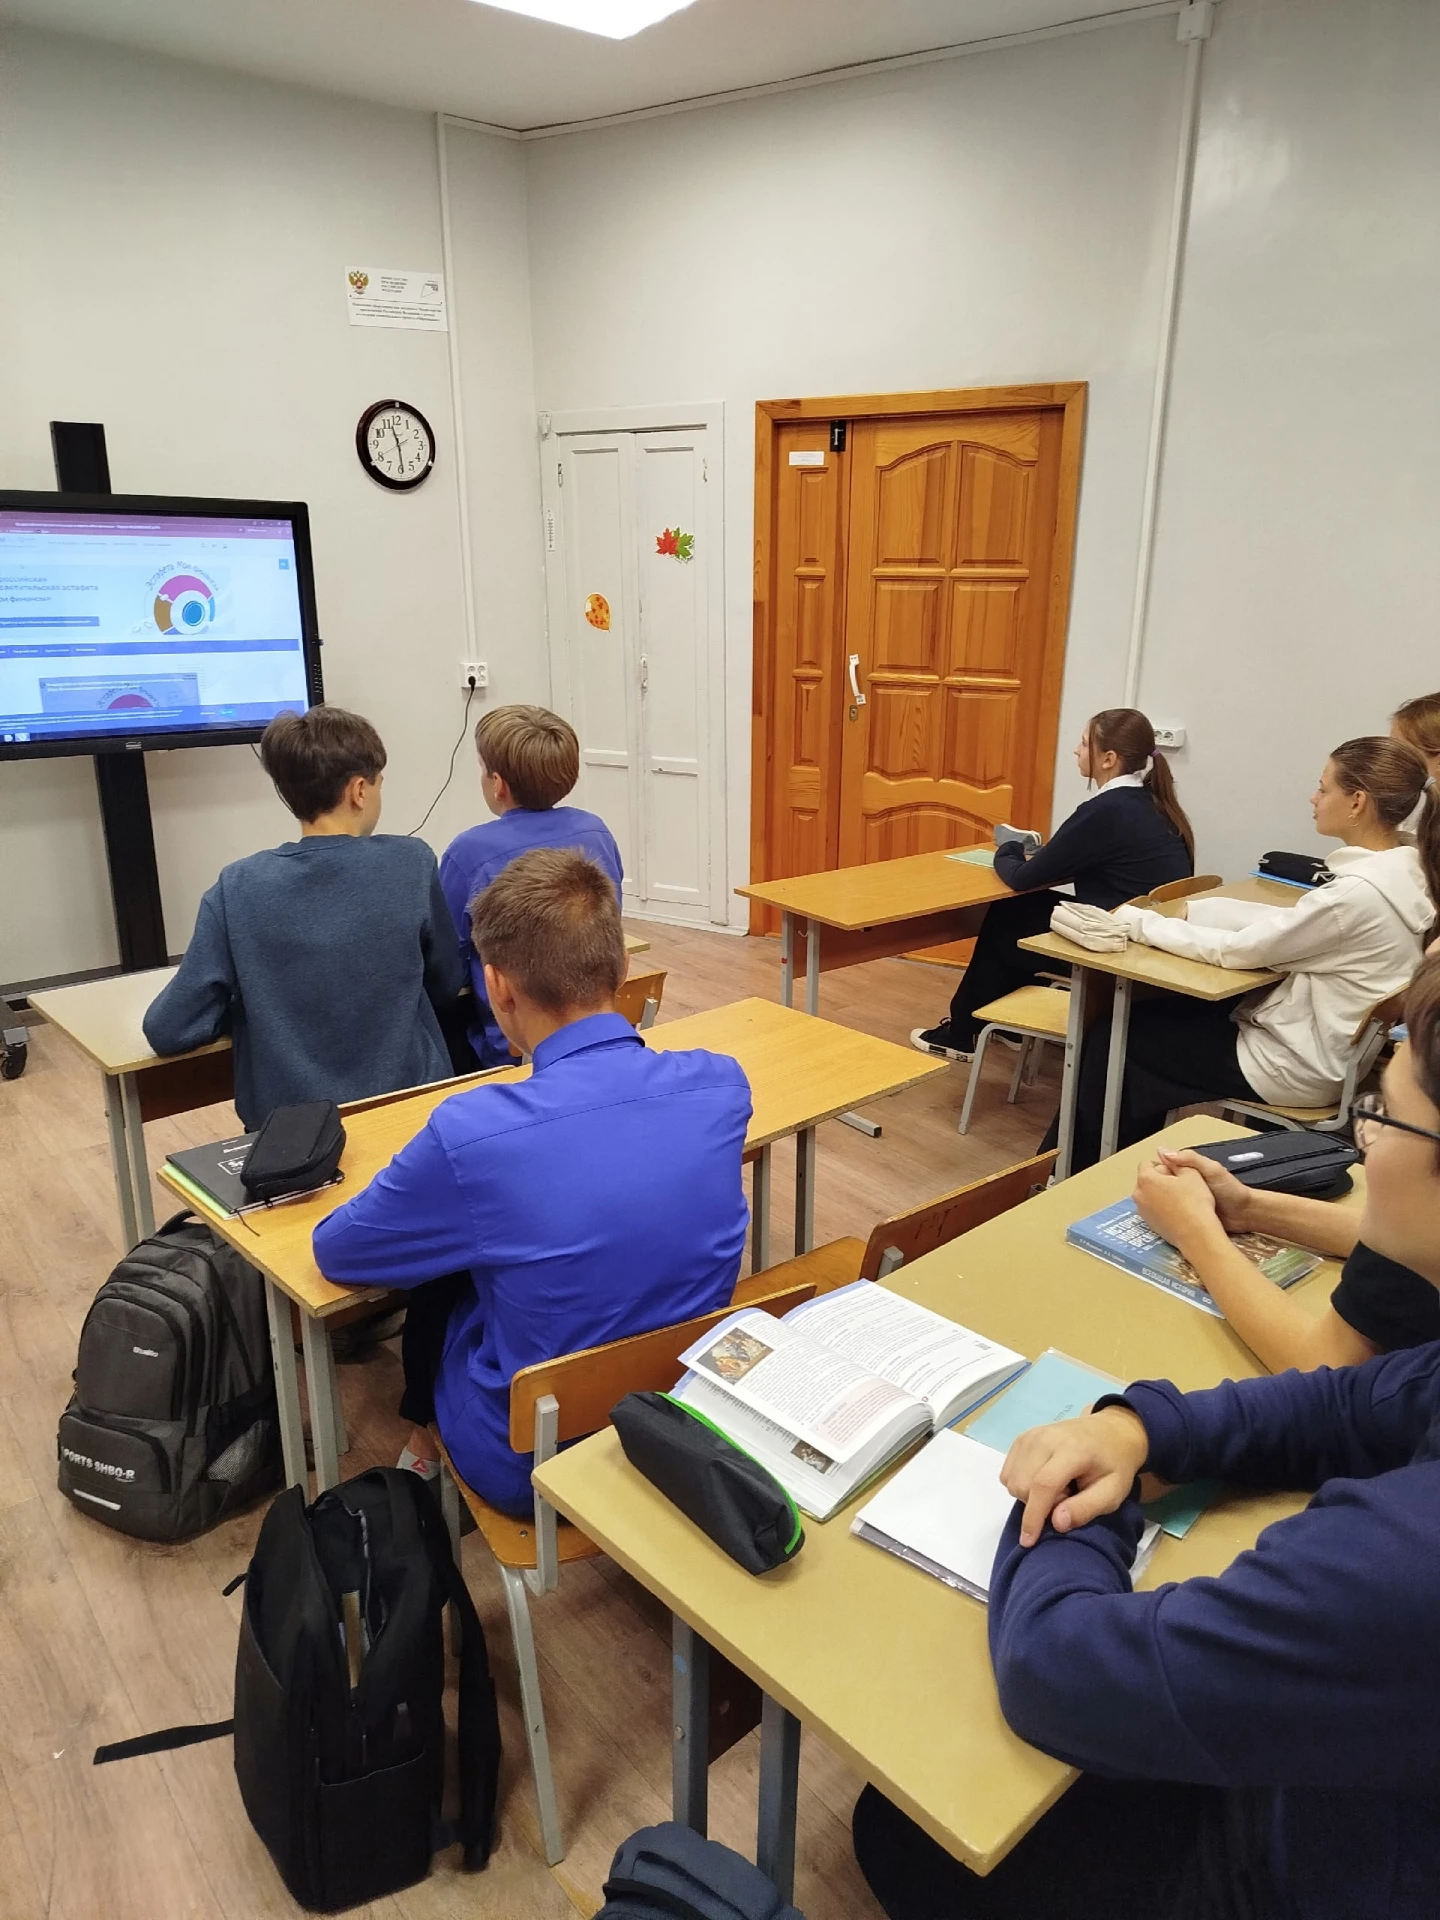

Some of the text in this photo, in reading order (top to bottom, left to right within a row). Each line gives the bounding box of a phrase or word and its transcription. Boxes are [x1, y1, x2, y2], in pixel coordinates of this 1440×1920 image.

[382, 419, 392, 429] 11
[392, 415, 402, 425] 12
[405, 419, 410, 430] 1
[375, 428, 385, 438] 10
[413, 429, 420, 439] 2
[373, 439, 379, 449] 9
[418, 440, 424, 450] 3
[377, 451, 385, 462] 8
[415, 452, 421, 462] 4
[386, 461, 393, 471] 7
[397, 464, 404, 475] 6
[408, 461, 415, 471] 5
